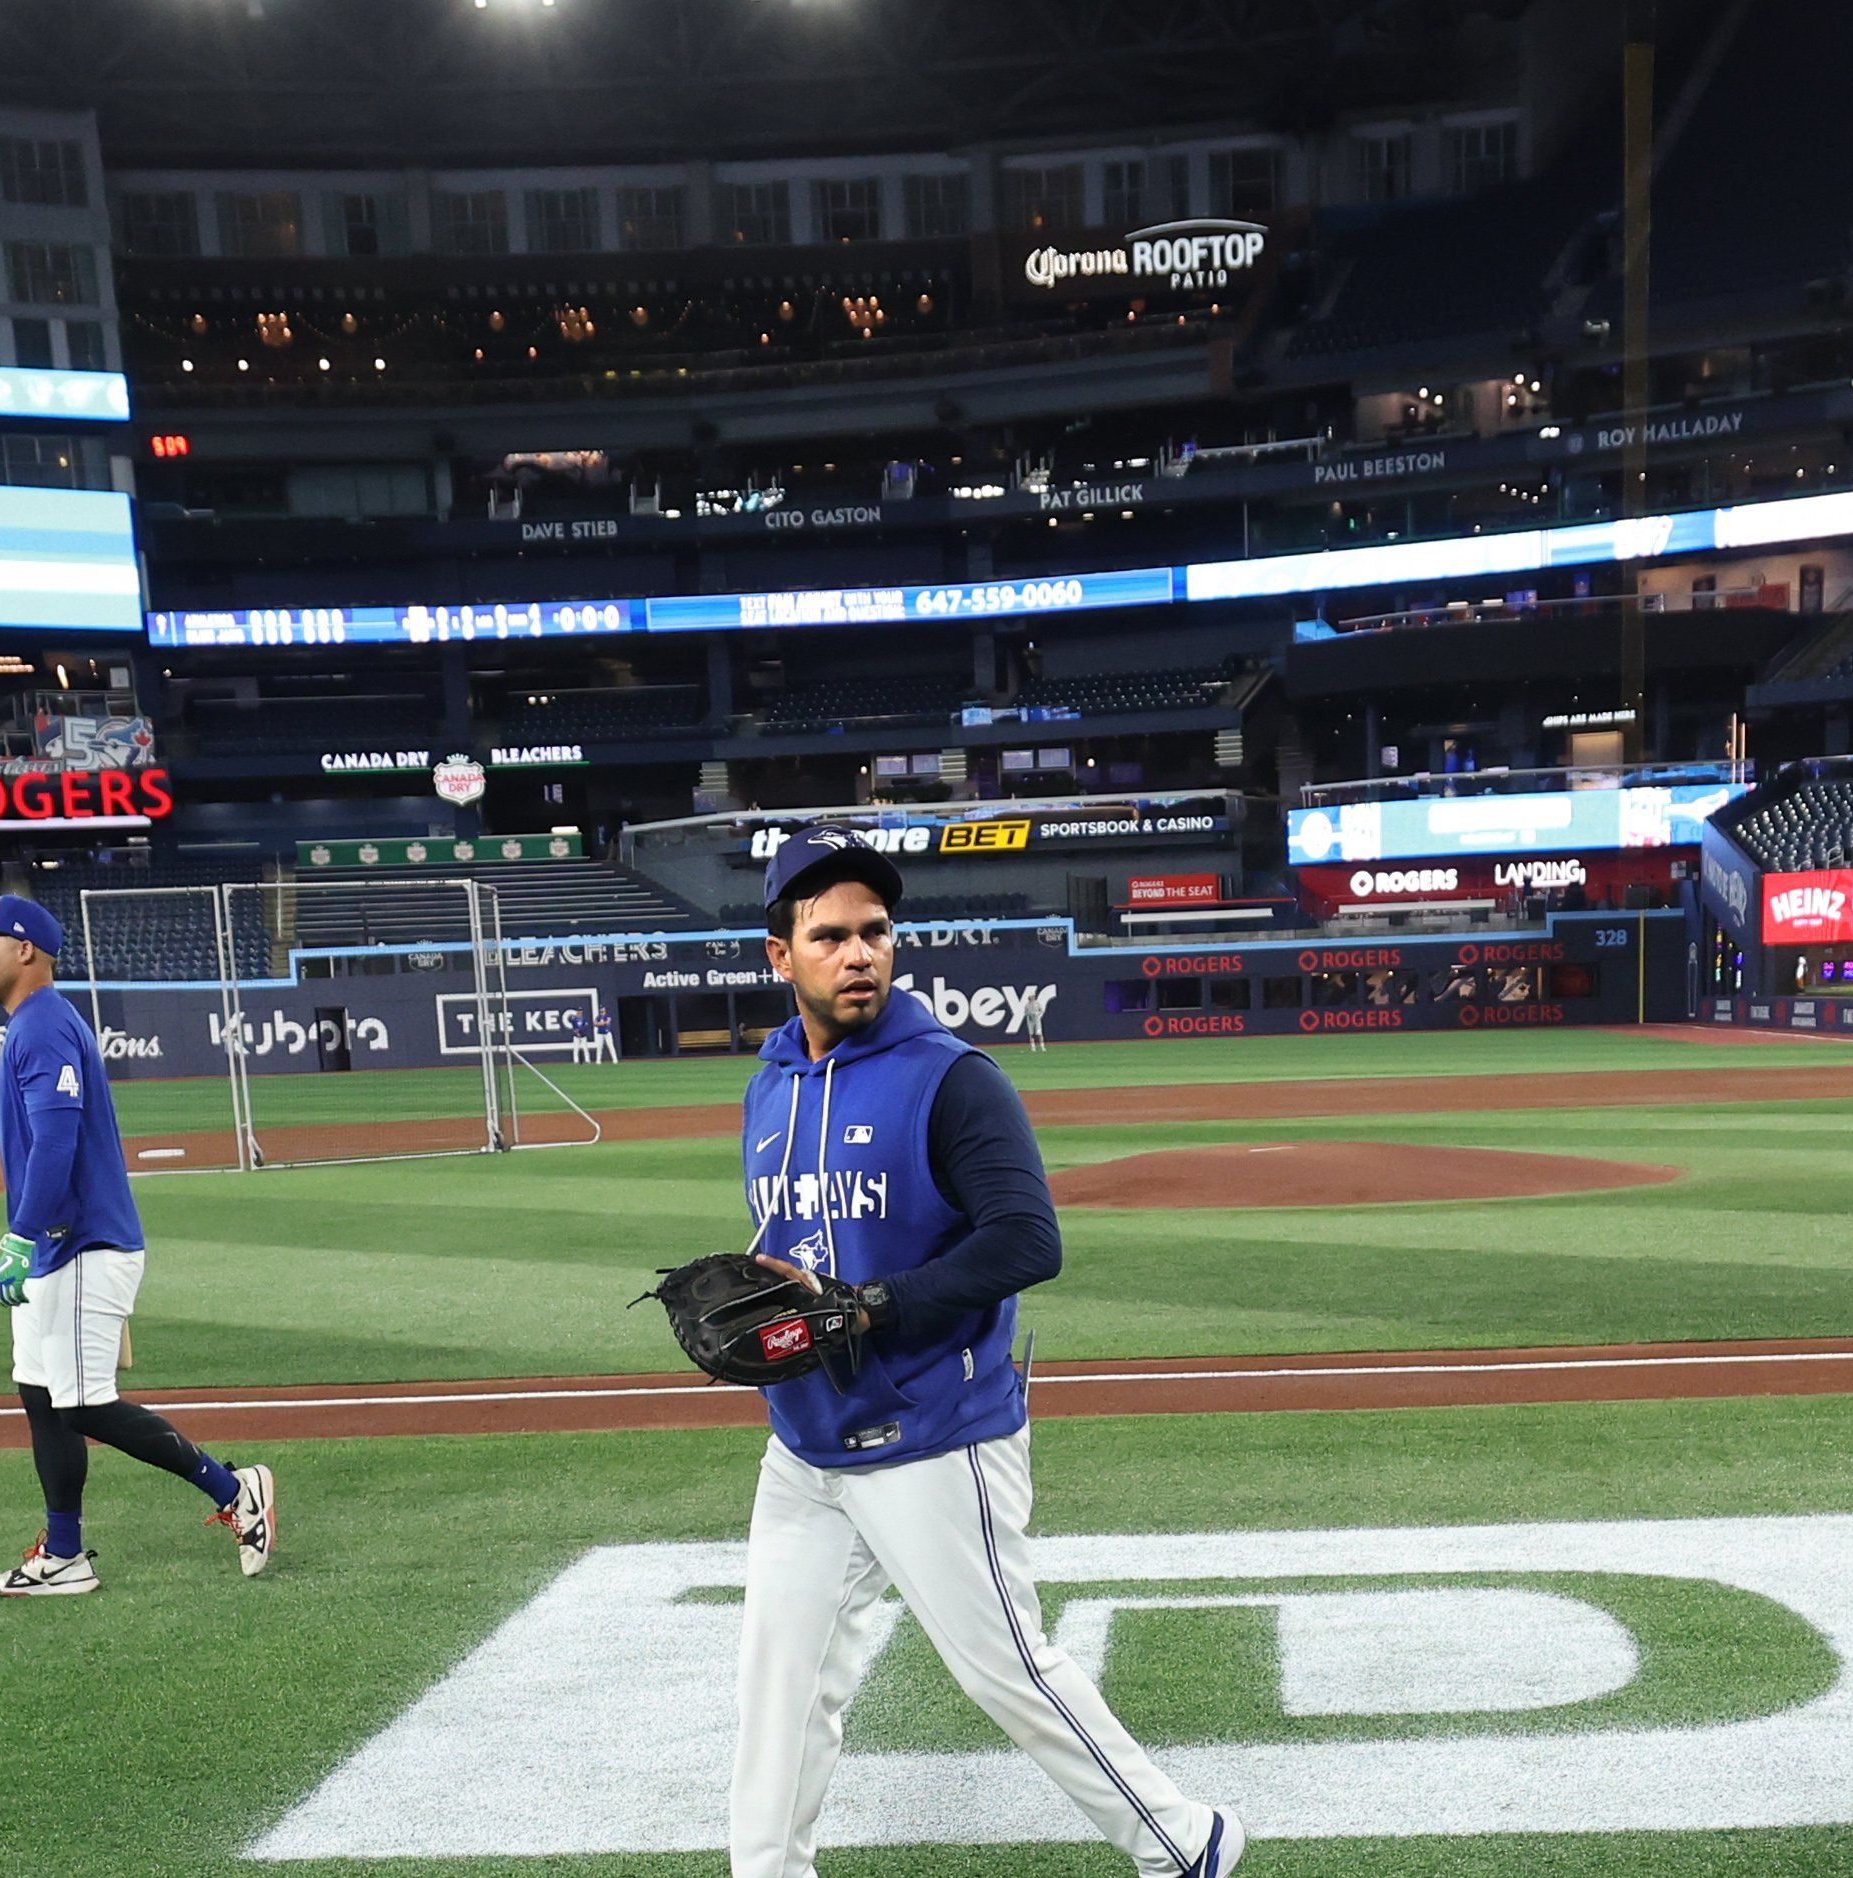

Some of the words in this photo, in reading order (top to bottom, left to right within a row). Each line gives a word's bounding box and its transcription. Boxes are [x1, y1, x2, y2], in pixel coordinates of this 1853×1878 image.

[1026, 245, 1129, 289] Corona
[1132, 233, 1265, 276] ROOFTOP
[1170, 269, 1228, 290] PATIO
[1598, 427, 1639, 449] ROY
[1644, 413, 1744, 442] HALLADAY
[1314, 459, 1358, 483] PAUL
[1363, 450, 1446, 478] BEESTON
[1039, 490, 1074, 510] PAT
[1077, 483, 1144, 506] GILLICK
[764, 508, 805, 529] CITO
[810, 505, 882, 526] GASTON
[521, 521, 565, 541] DAVE
[571, 518, 619, 538] STIEB
[915, 579, 1084, 615] 647-559-0060
[321, 751, 394, 771] CANADA
[395, 750, 430, 769] DRY
[490, 744, 583, 765] BLEACHERS
[434, 772, 487, 785] CANADA
[944, 822, 1033, 850] BET
[1040, 818, 1141, 838] SPORTSBOOK
[1142, 818, 1154, 833] &
[1155, 814, 1214, 833] CASINO
[1165, 886, 1186, 897] THE
[1187, 885, 1214, 896] SEAT
[1375, 868, 1459, 894] ROGERS
[1770, 887, 1846, 922] HEINZ
[1595, 929, 1628, 947] 328
[1321, 948, 1401, 968] ROGERS
[1483, 943, 1566, 961] ROGERS
[1165, 955, 1243, 973] ROGERS
[643, 971, 701, 989] Active
[456, 1011, 514, 1034] THE
[1167, 1015, 1245, 1033] ROGERS
[1323, 1009, 1403, 1028] ROGERS
[1483, 1005, 1564, 1023] ROGERS
[208, 1009, 390, 1056] Kubota
[55, 1064, 81, 1098] 4
